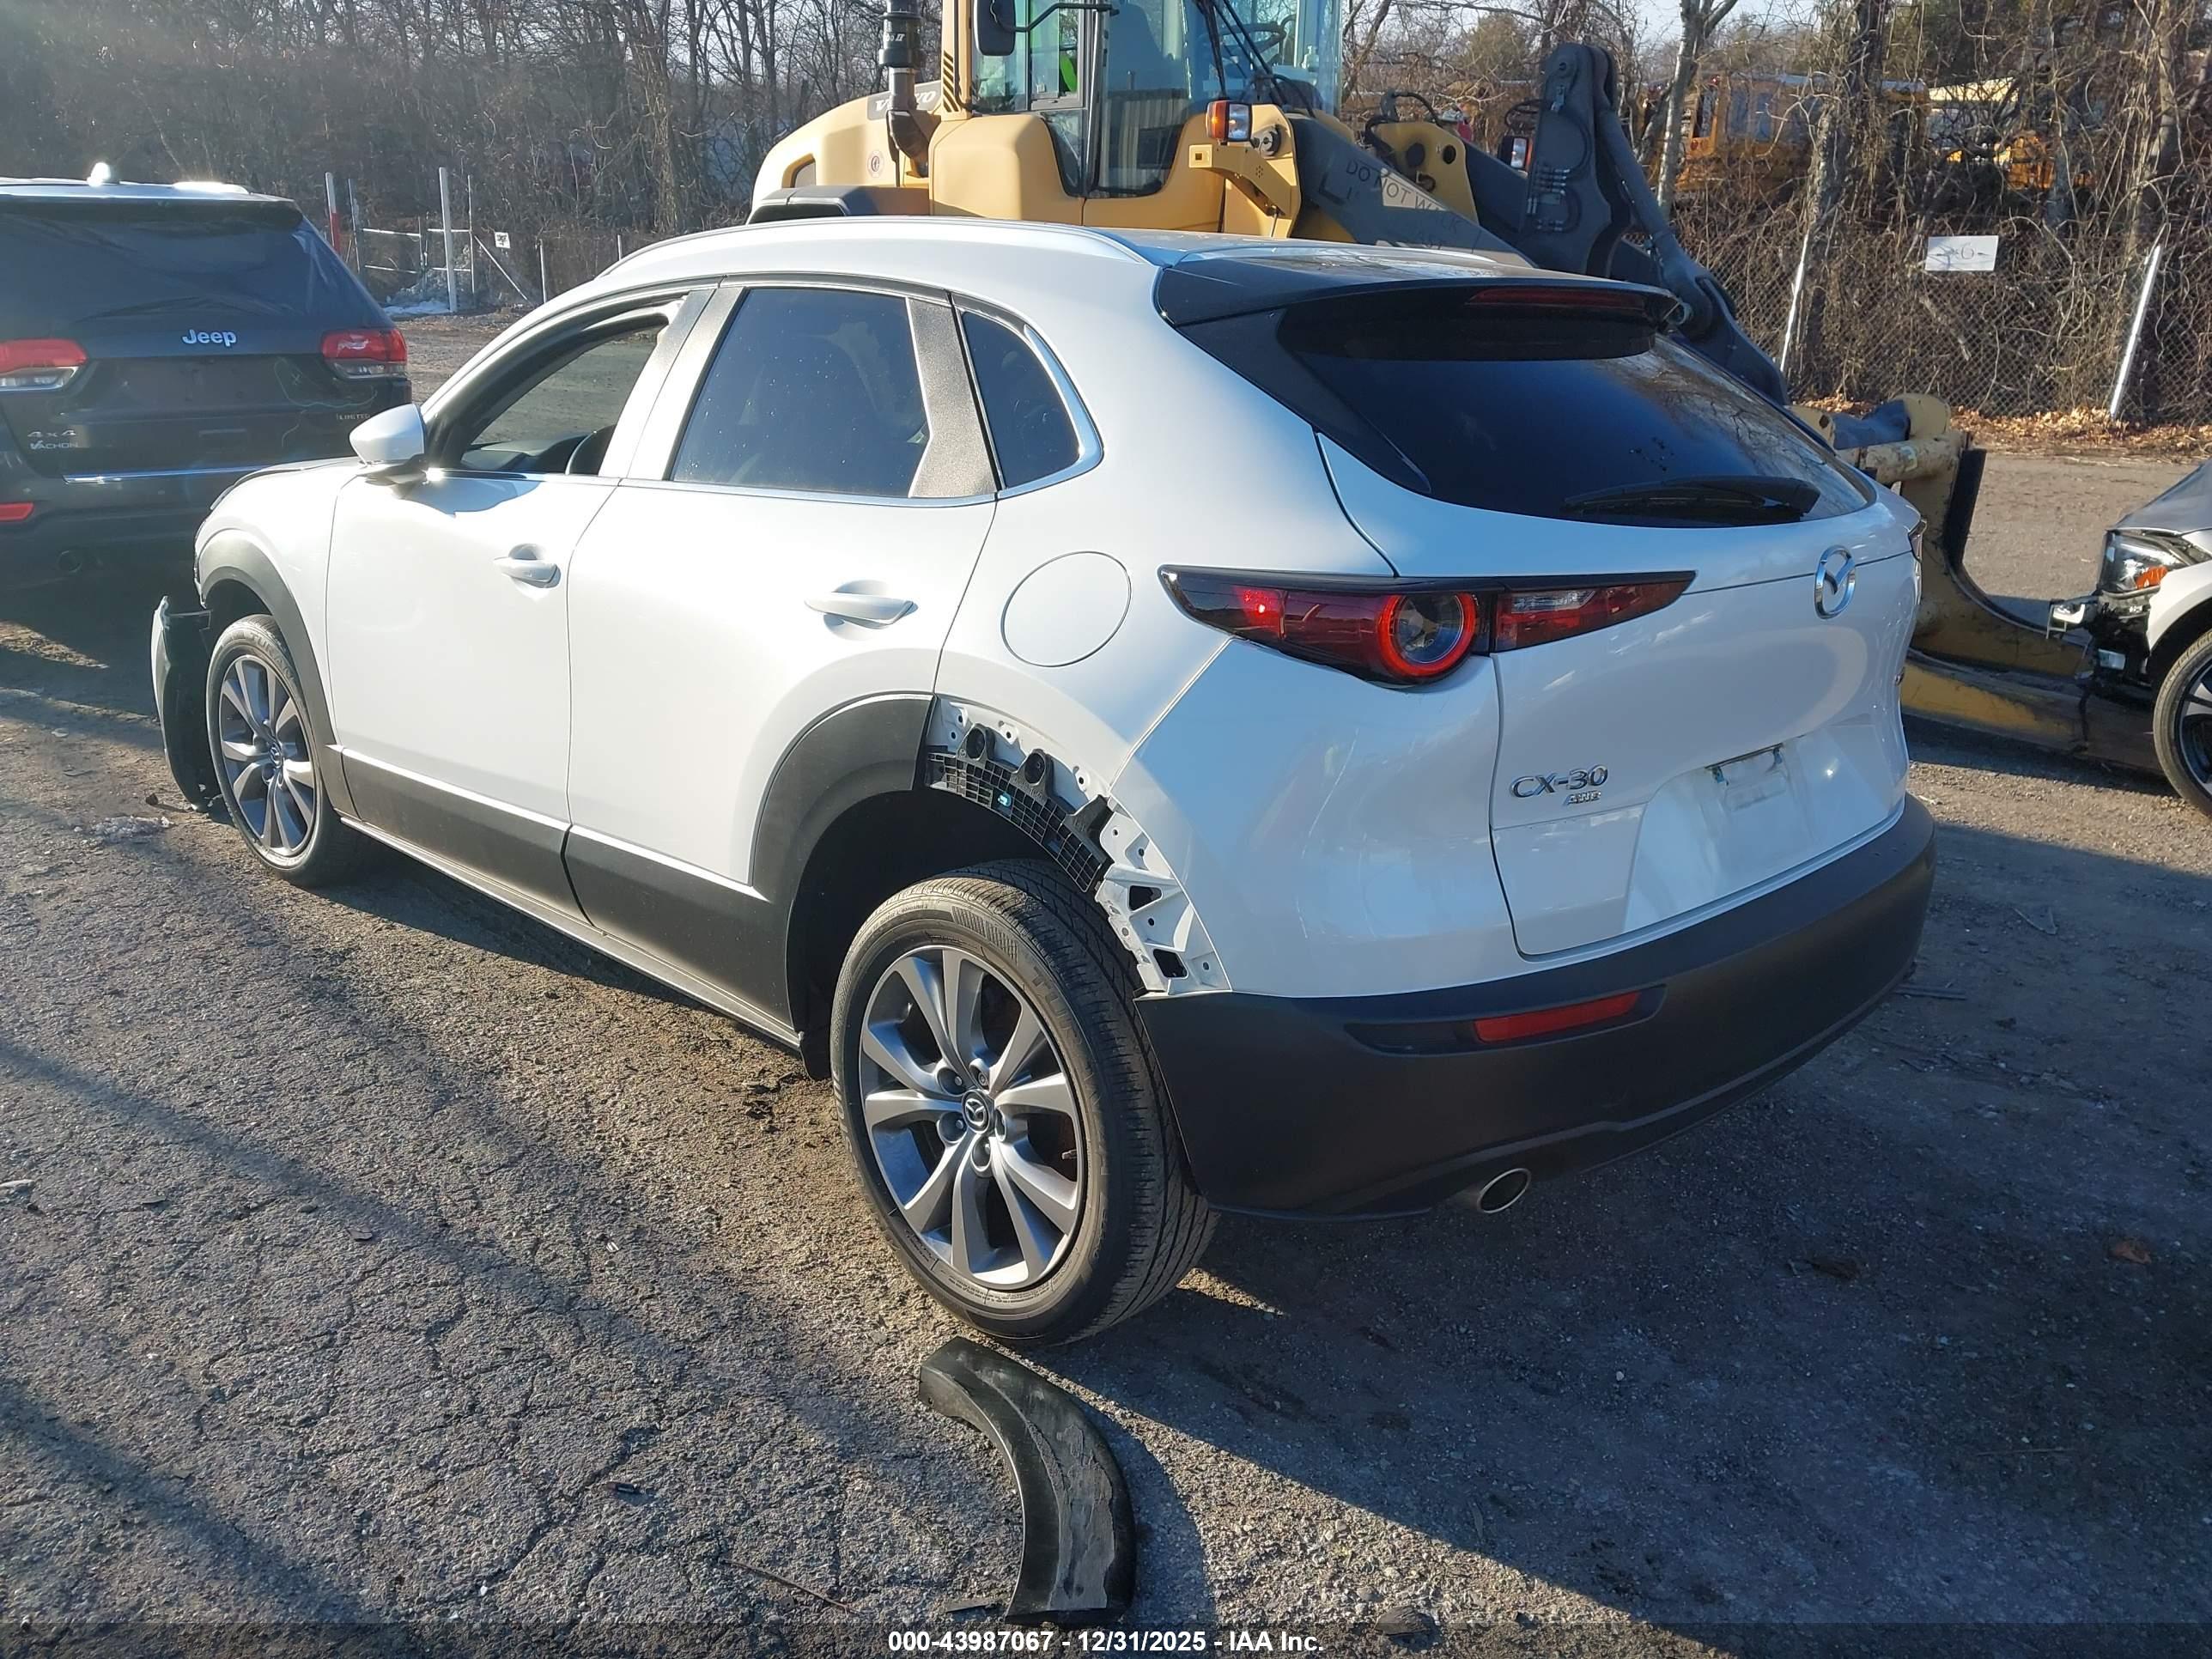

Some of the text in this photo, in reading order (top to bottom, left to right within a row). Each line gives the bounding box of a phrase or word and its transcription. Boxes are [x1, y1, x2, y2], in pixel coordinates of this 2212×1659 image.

[875, 90, 936, 112] VVO
[1346, 159, 1370, 182] DO
[1373, 174, 1411, 204] NOT
[1414, 194, 1463, 234] WLK
[182, 329, 237, 347] Jeep
[1510, 763, 1609, 798] CX-30
[1563, 789, 1602, 806] AWD
